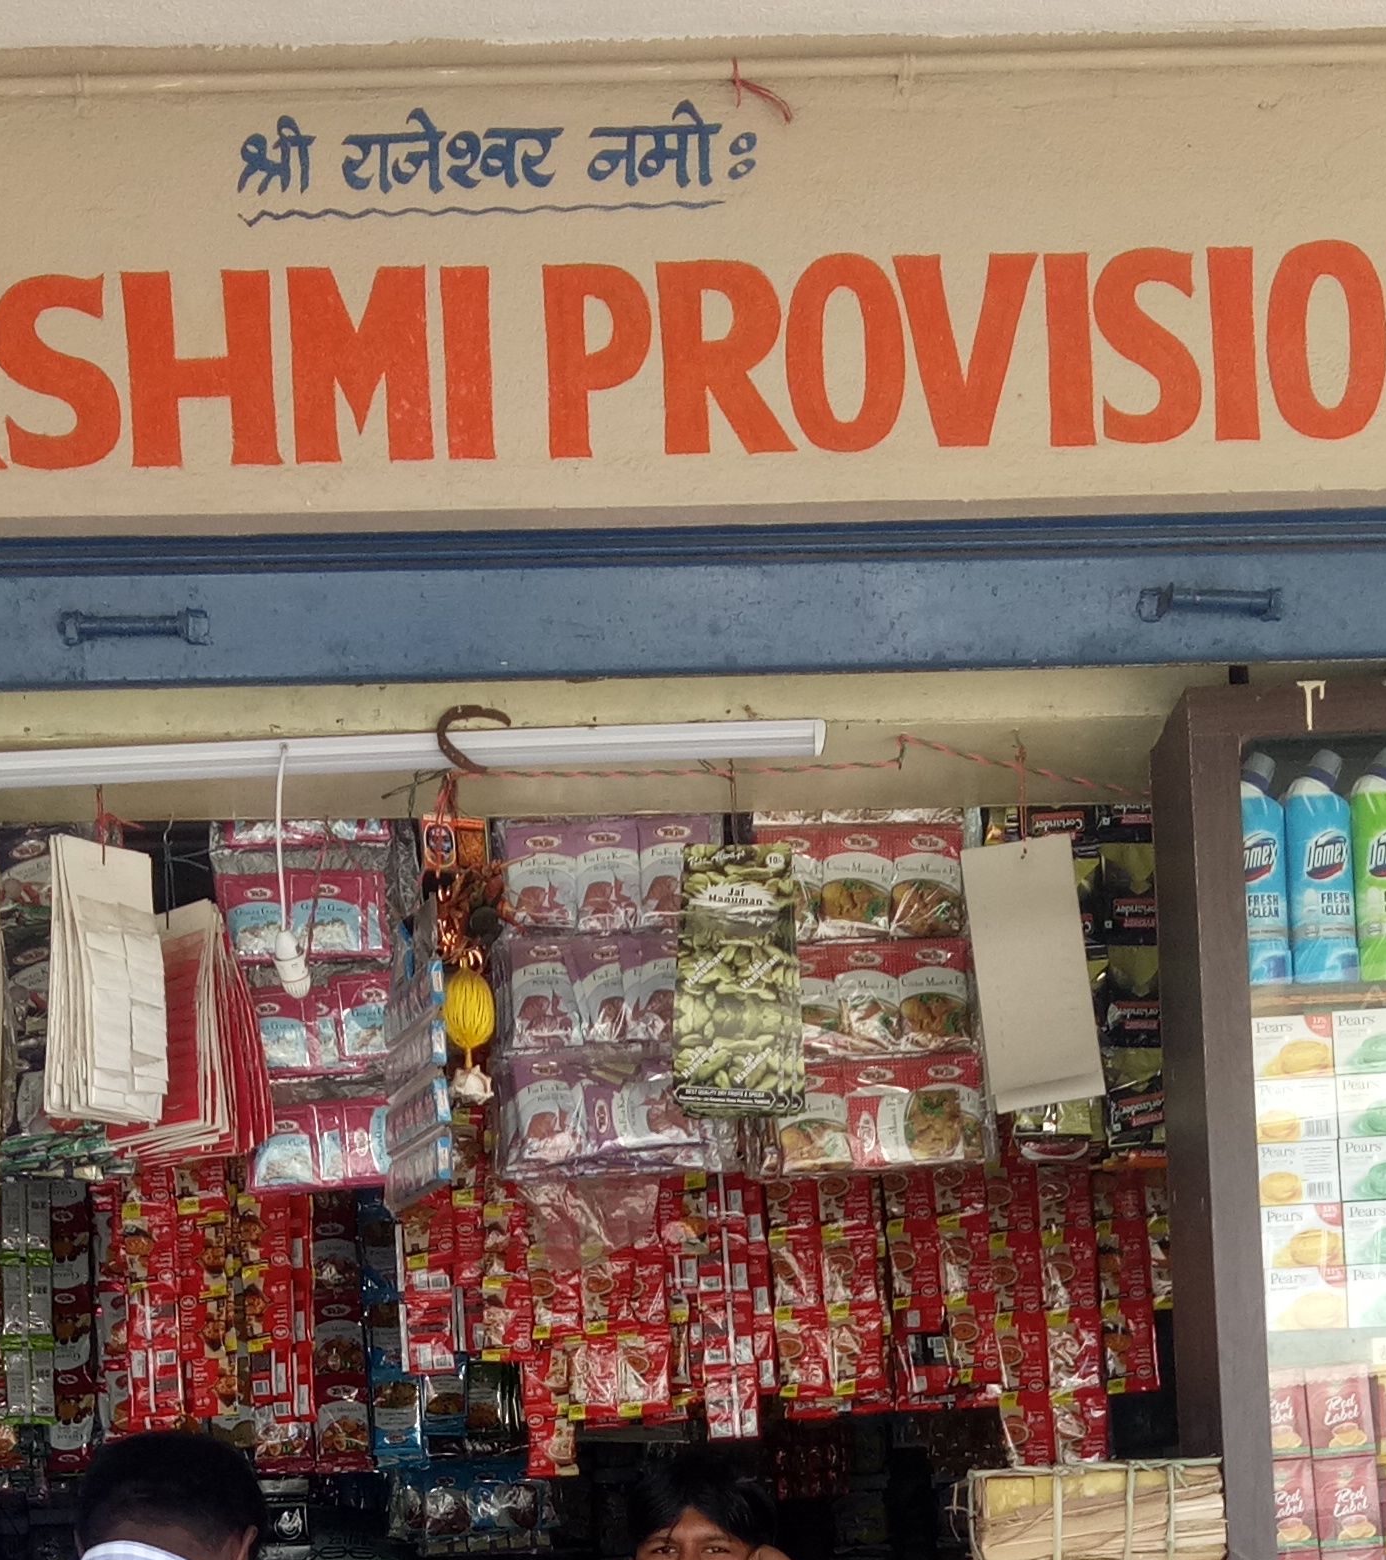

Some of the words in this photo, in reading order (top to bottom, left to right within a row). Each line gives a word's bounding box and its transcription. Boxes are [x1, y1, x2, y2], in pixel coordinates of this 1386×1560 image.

[237, 114, 316, 196] श्री
[342, 107, 565, 195] राजेश्वर
[728, 888, 745, 896] Jai
[1350, 1206, 1386, 1218] Pears
[1326, 1394, 1355, 1412] Red
[1324, 1407, 1361, 1425] Label
[1274, 1489, 1301, 1505] Red
[1335, 1488, 1365, 1505] Red
[1334, 1500, 1369, 1517] Label
